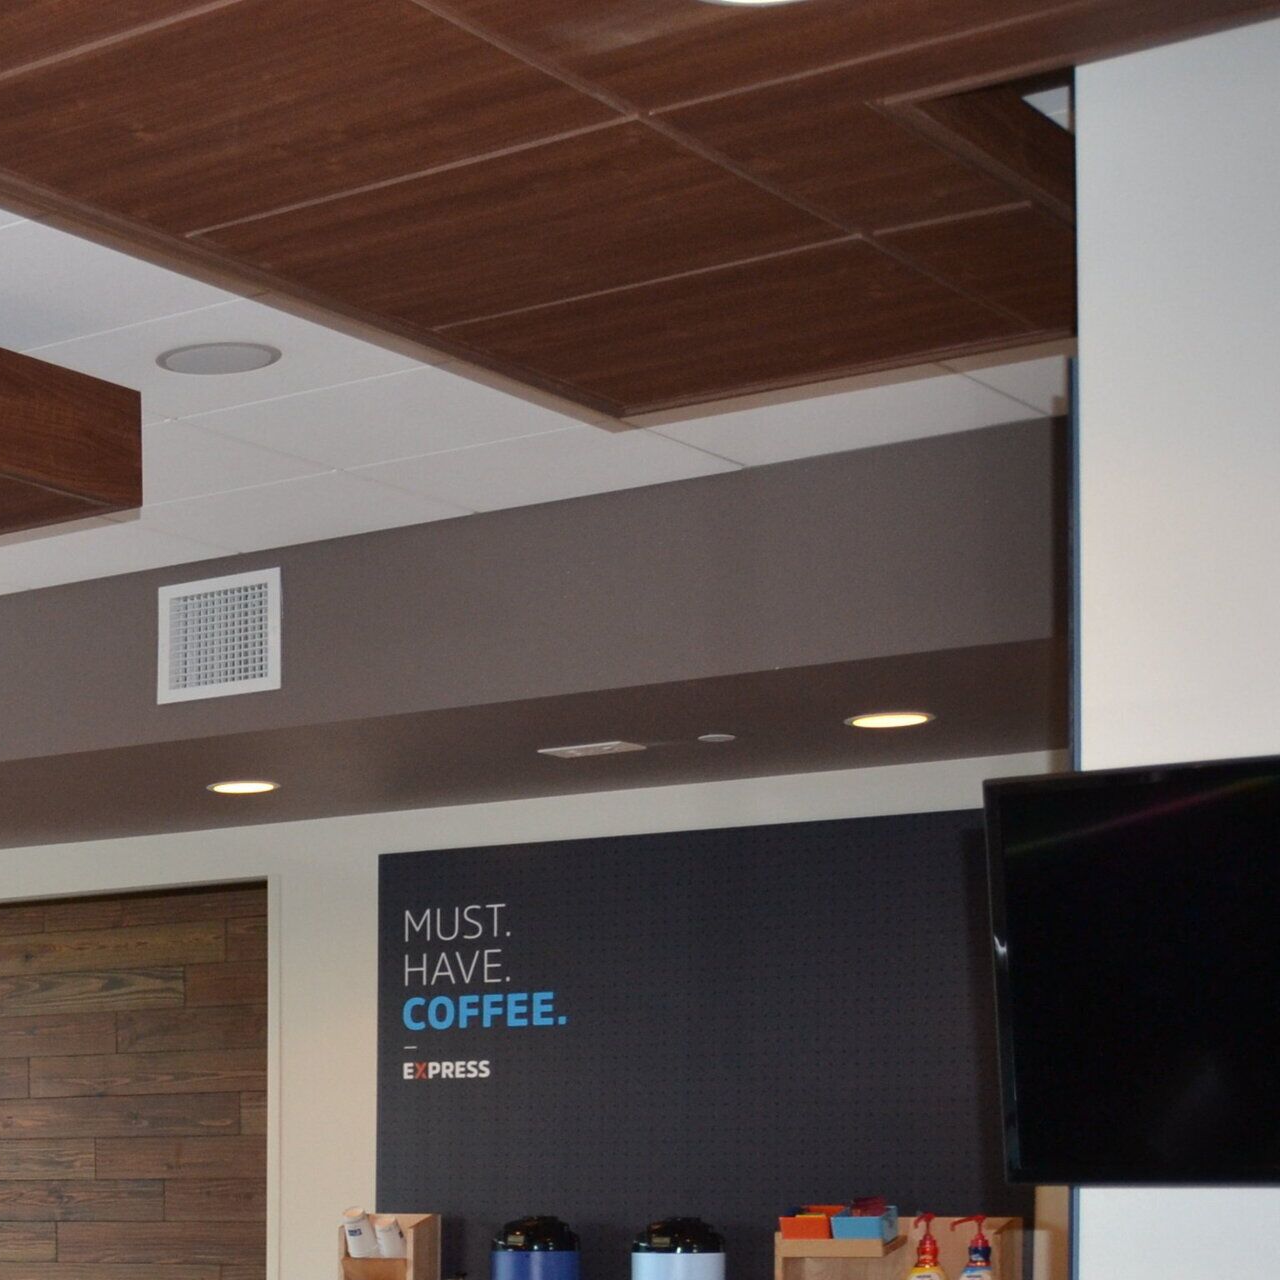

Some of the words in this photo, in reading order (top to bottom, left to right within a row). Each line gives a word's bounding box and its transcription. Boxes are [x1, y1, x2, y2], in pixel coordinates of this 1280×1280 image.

[405, 903, 511, 942] MUST.
[405, 949, 511, 986] HAVE.
[402, 991, 567, 1031] COFFEE.
[403, 1060, 491, 1079] EXPRESS
